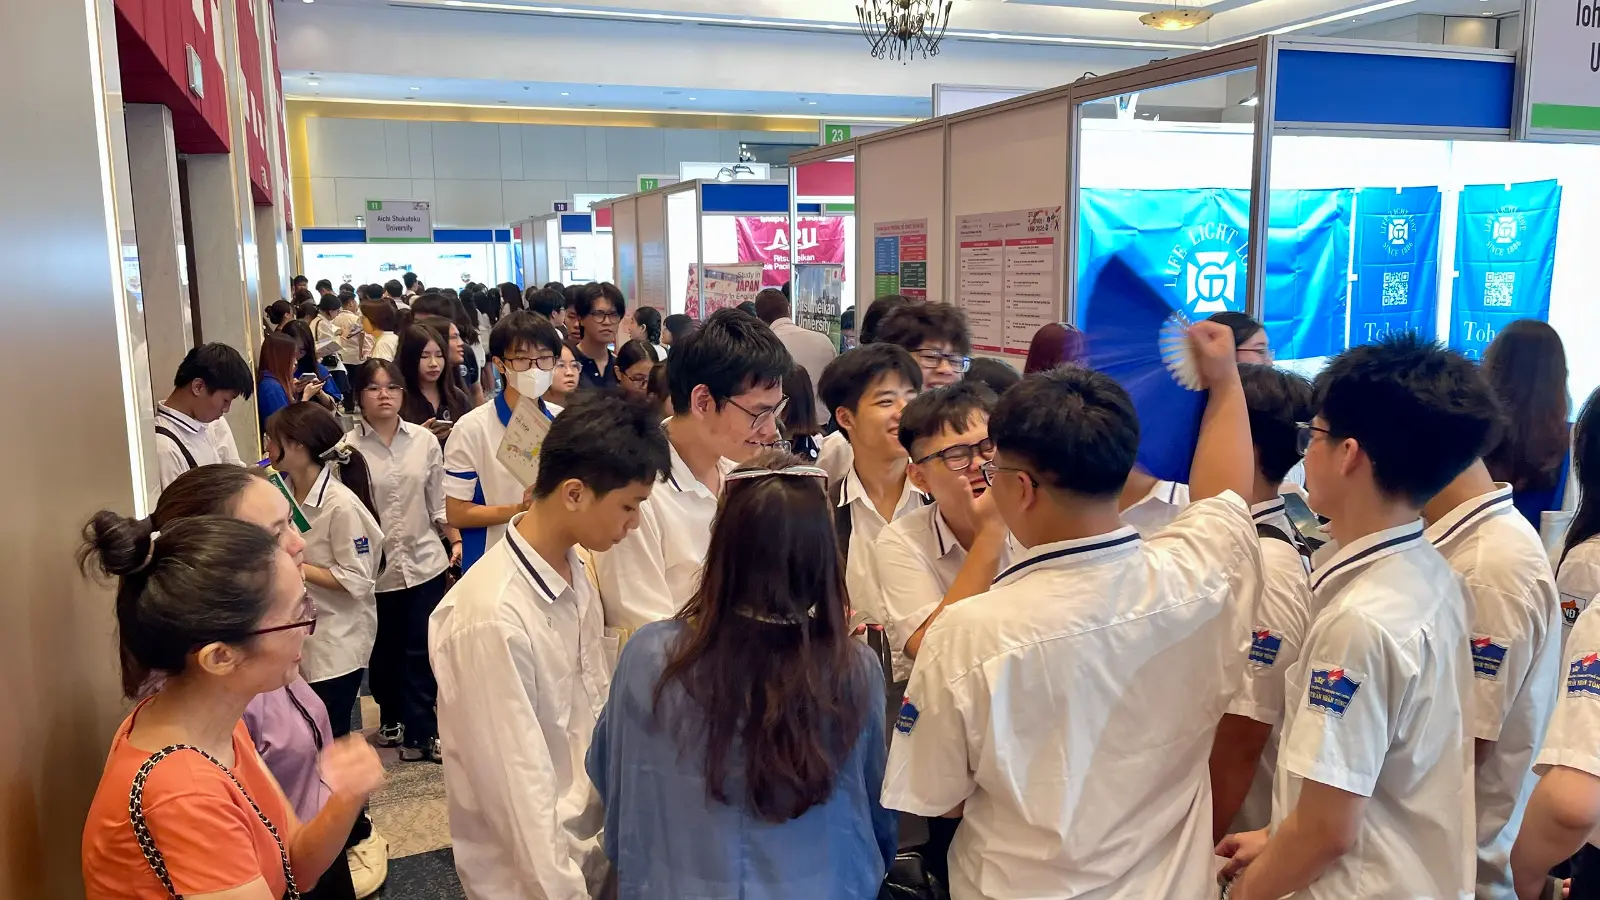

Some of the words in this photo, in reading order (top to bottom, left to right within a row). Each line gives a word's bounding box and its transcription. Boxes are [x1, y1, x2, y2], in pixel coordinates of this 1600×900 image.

[831, 129, 843, 142] 23
[645, 180, 653, 190] 17
[371, 202, 378, 210] 11
[557, 203, 565, 211] 10
[391, 214, 421, 222] Shukutoku
[385, 224, 413, 232] University
[773, 254, 815, 262] Ritseikan
[1164, 244, 1188, 288] LIFE
[1188, 222, 1239, 246] LIGHT
[737, 271, 753, 279] Study
[736, 280, 760, 291] JAPAN
